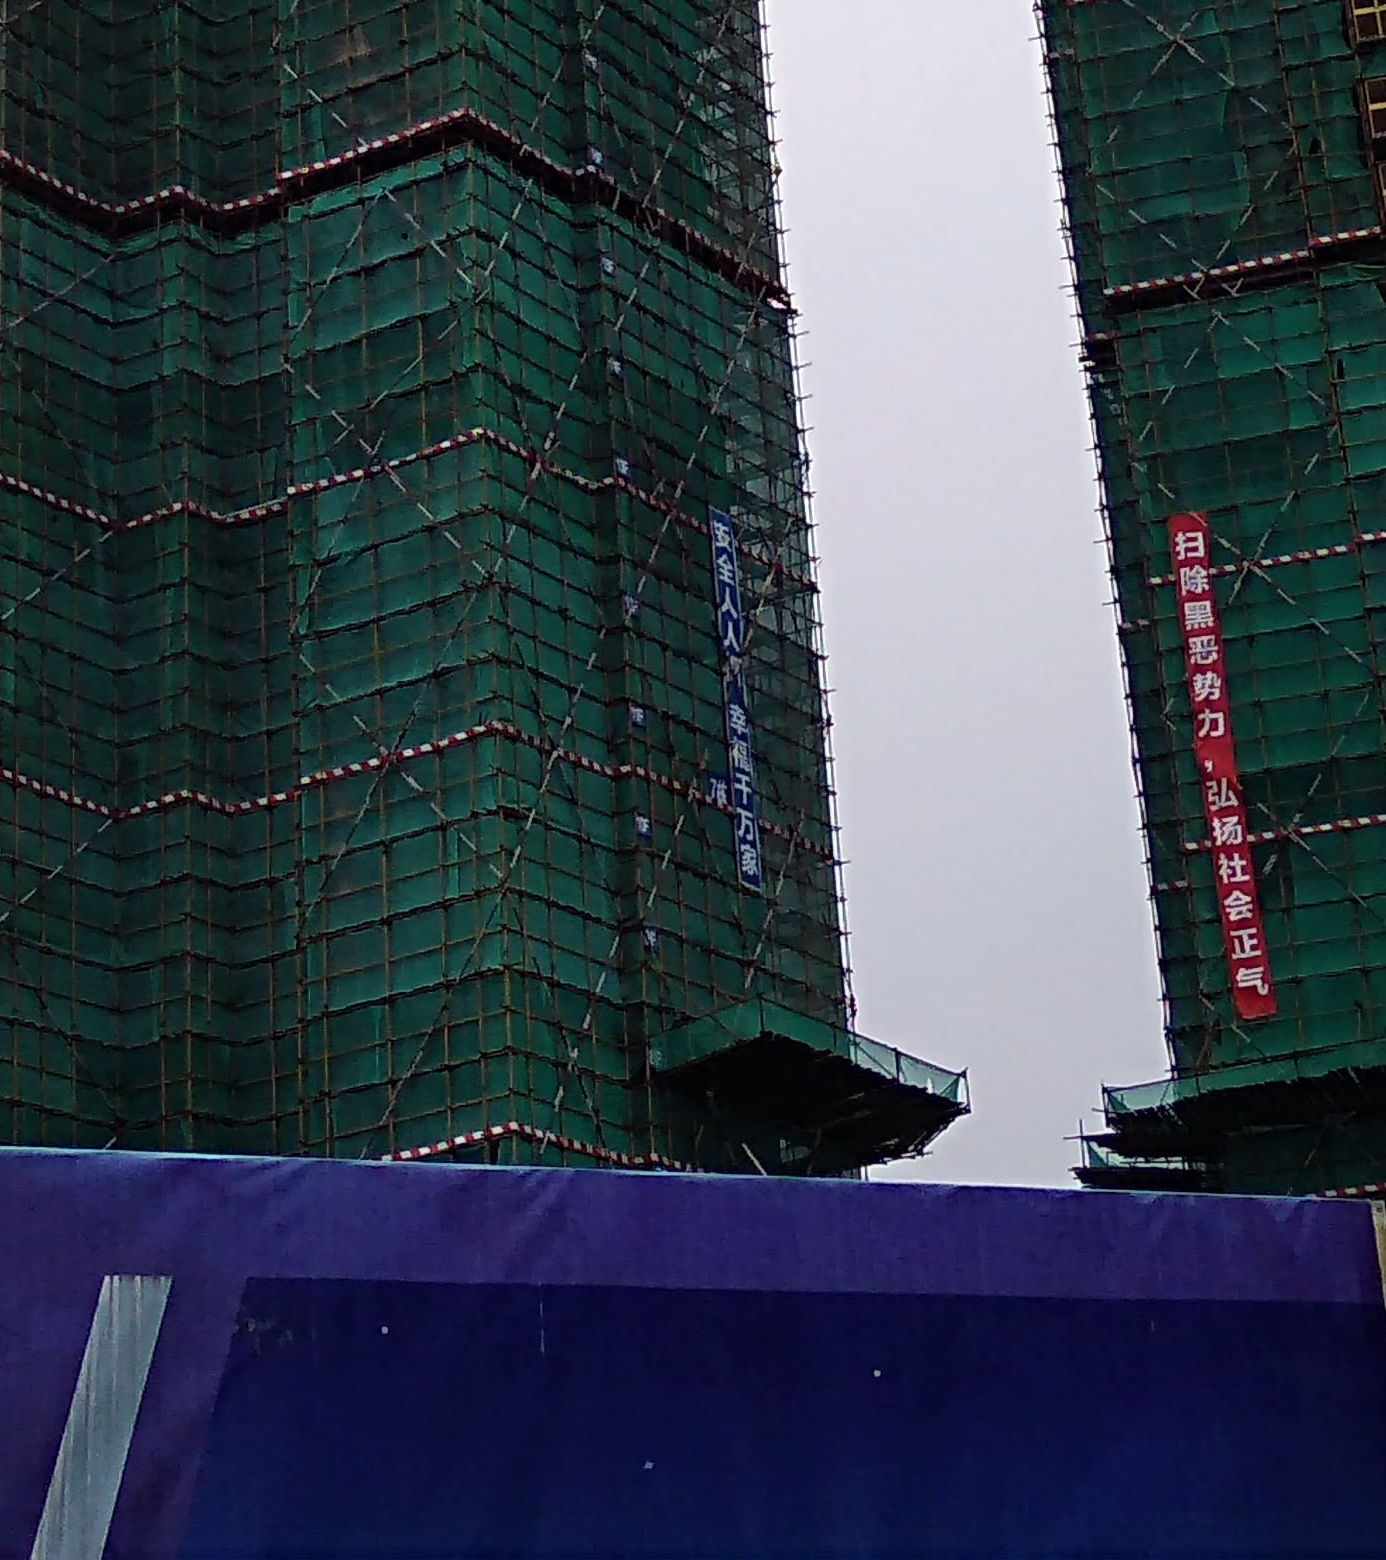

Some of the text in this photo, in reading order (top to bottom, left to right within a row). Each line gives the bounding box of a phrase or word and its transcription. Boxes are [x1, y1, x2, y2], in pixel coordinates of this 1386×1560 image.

[1175, 530, 1270, 996] 扫除黑恶势力，弘扬社会正气
